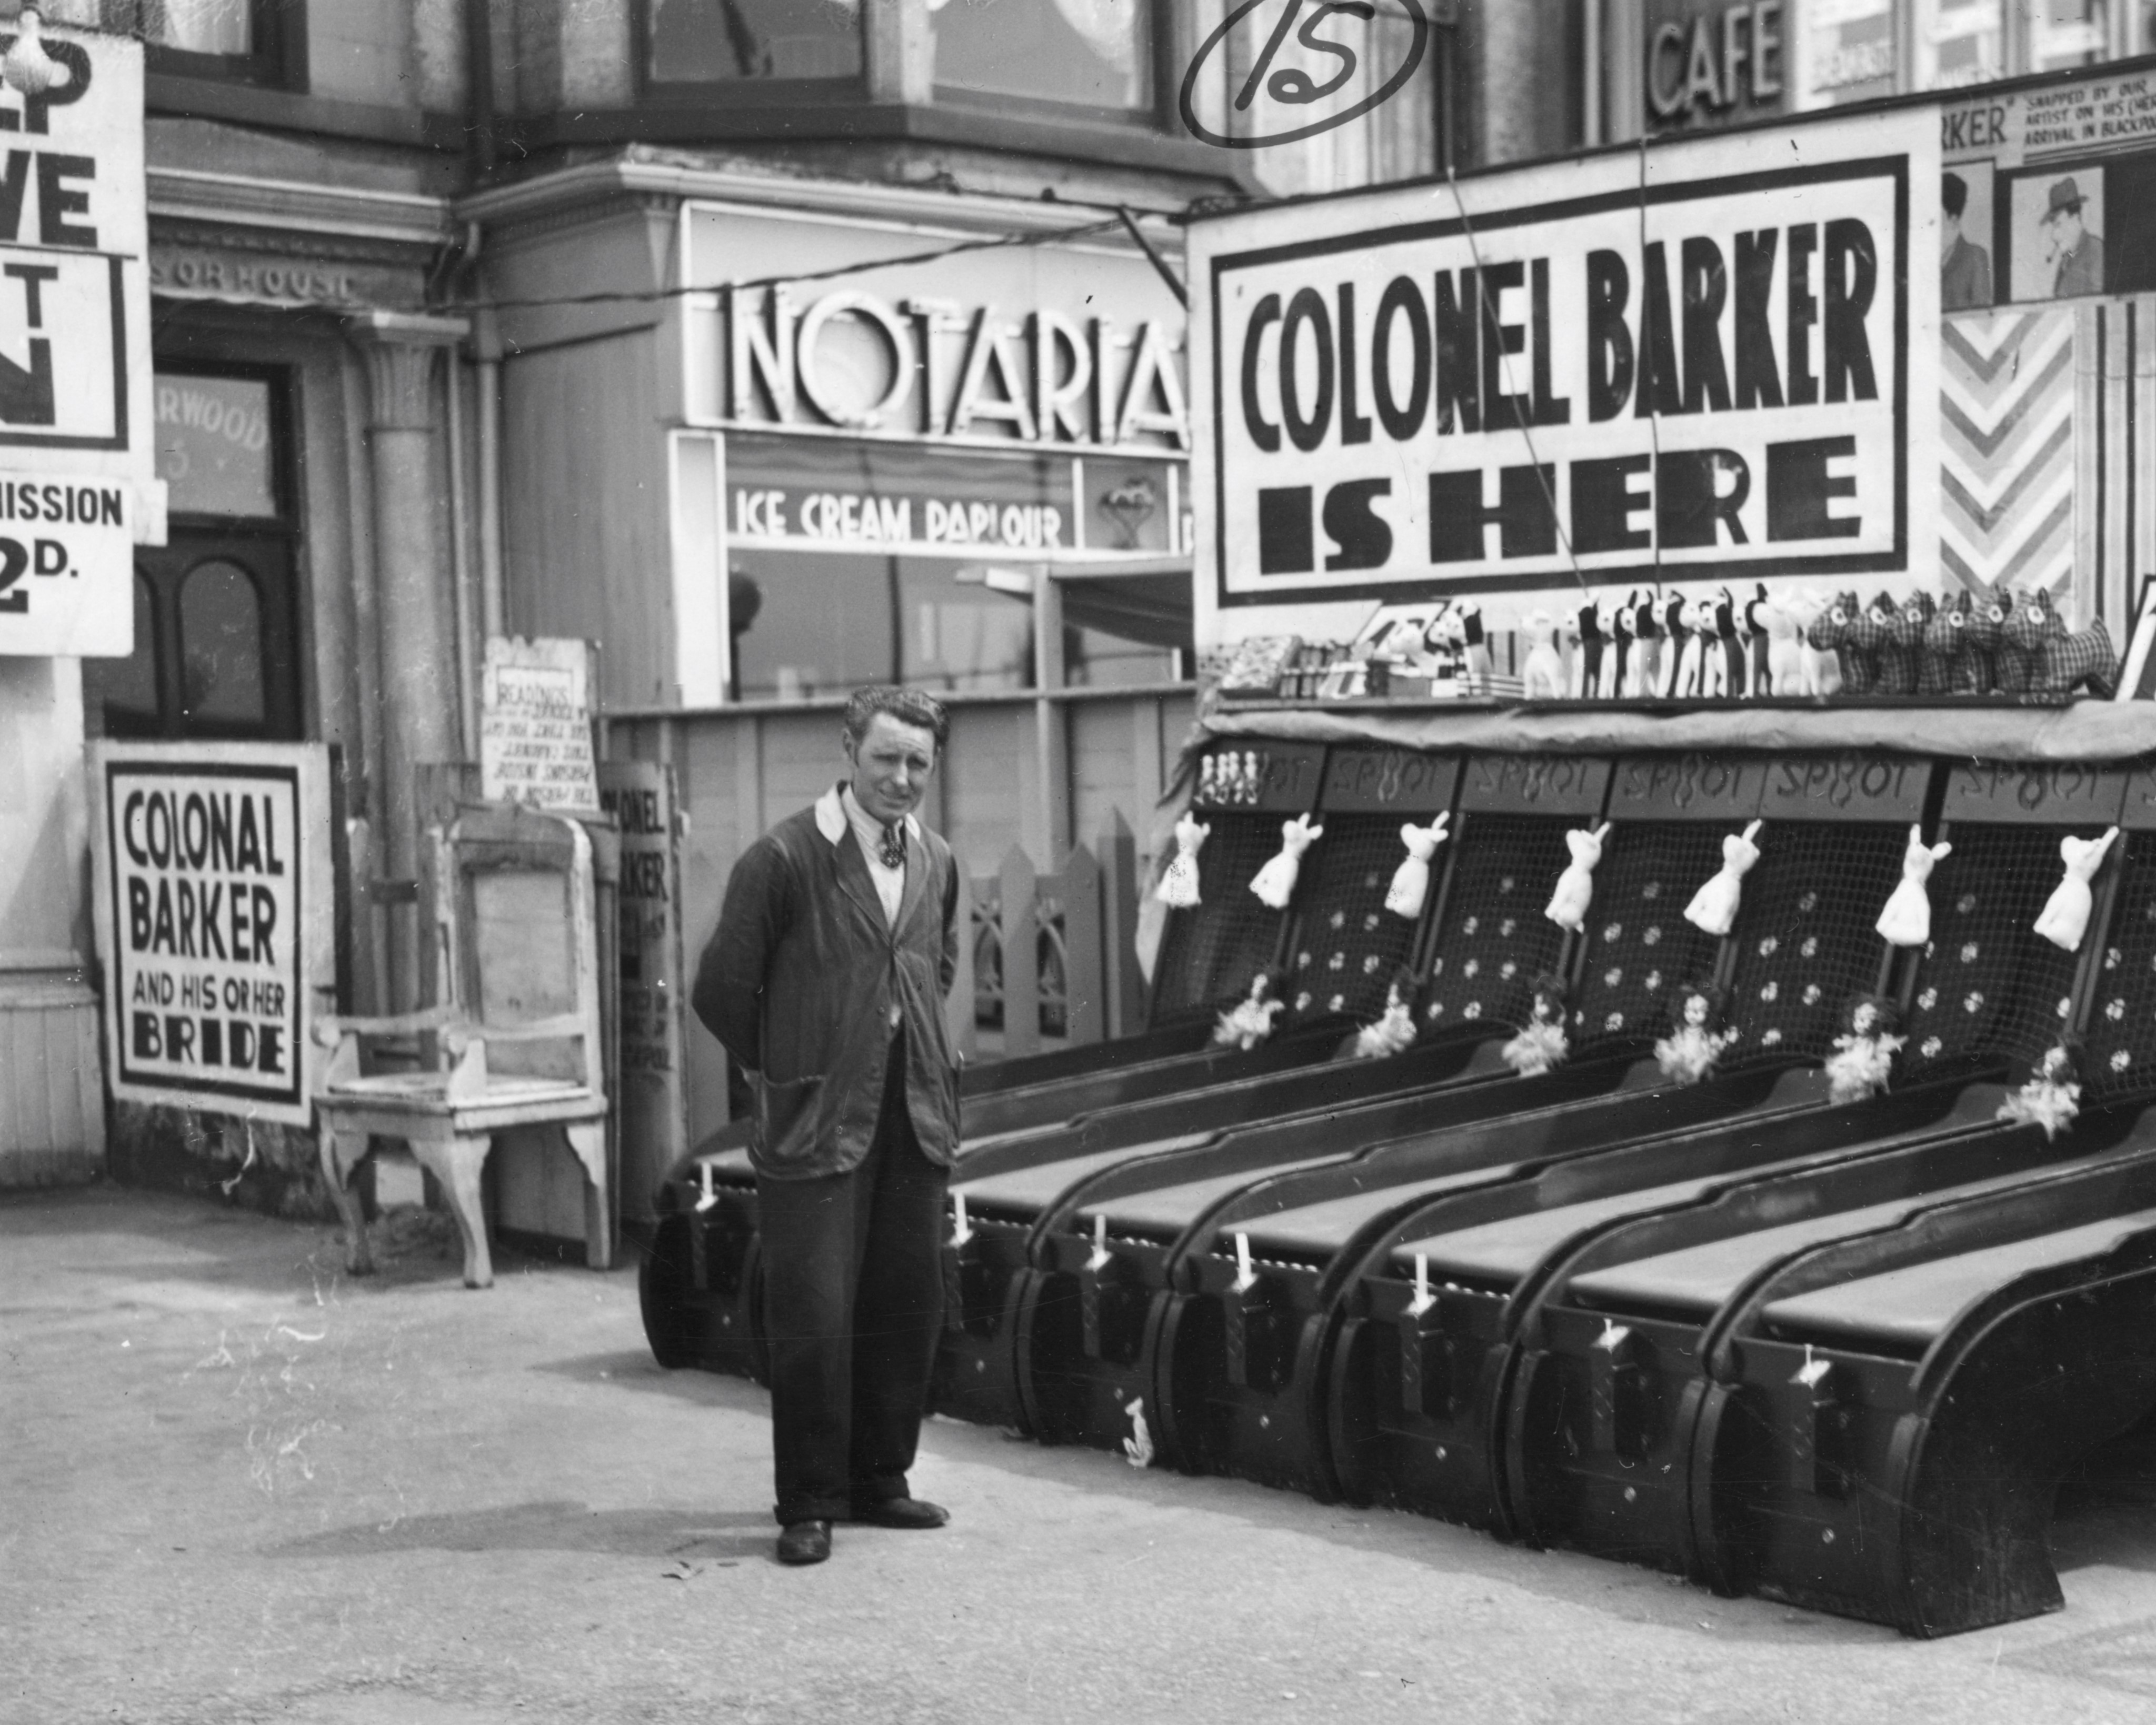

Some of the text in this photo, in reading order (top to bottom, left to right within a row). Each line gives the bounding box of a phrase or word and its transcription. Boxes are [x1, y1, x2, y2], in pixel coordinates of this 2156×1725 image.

[1649, 4, 1781, 117] CAFE
[2093, 87, 2108, 101] BY
[722, 282, 1191, 453] NOTARIA
[1241, 217, 1879, 454] COLONEL BARKER
[0, 481, 123, 526] ISSION
[736, 490, 787, 536] ICE
[800, 493, 911, 541] CREAM
[1258, 434, 1862, 576] IS HERE
[123, 790, 285, 876] COLONAL
[129, 875, 276, 966] BARKER
[133, 970, 285, 1018] AND HIS OR HER
[133, 1010, 286, 1074] BRIDE
